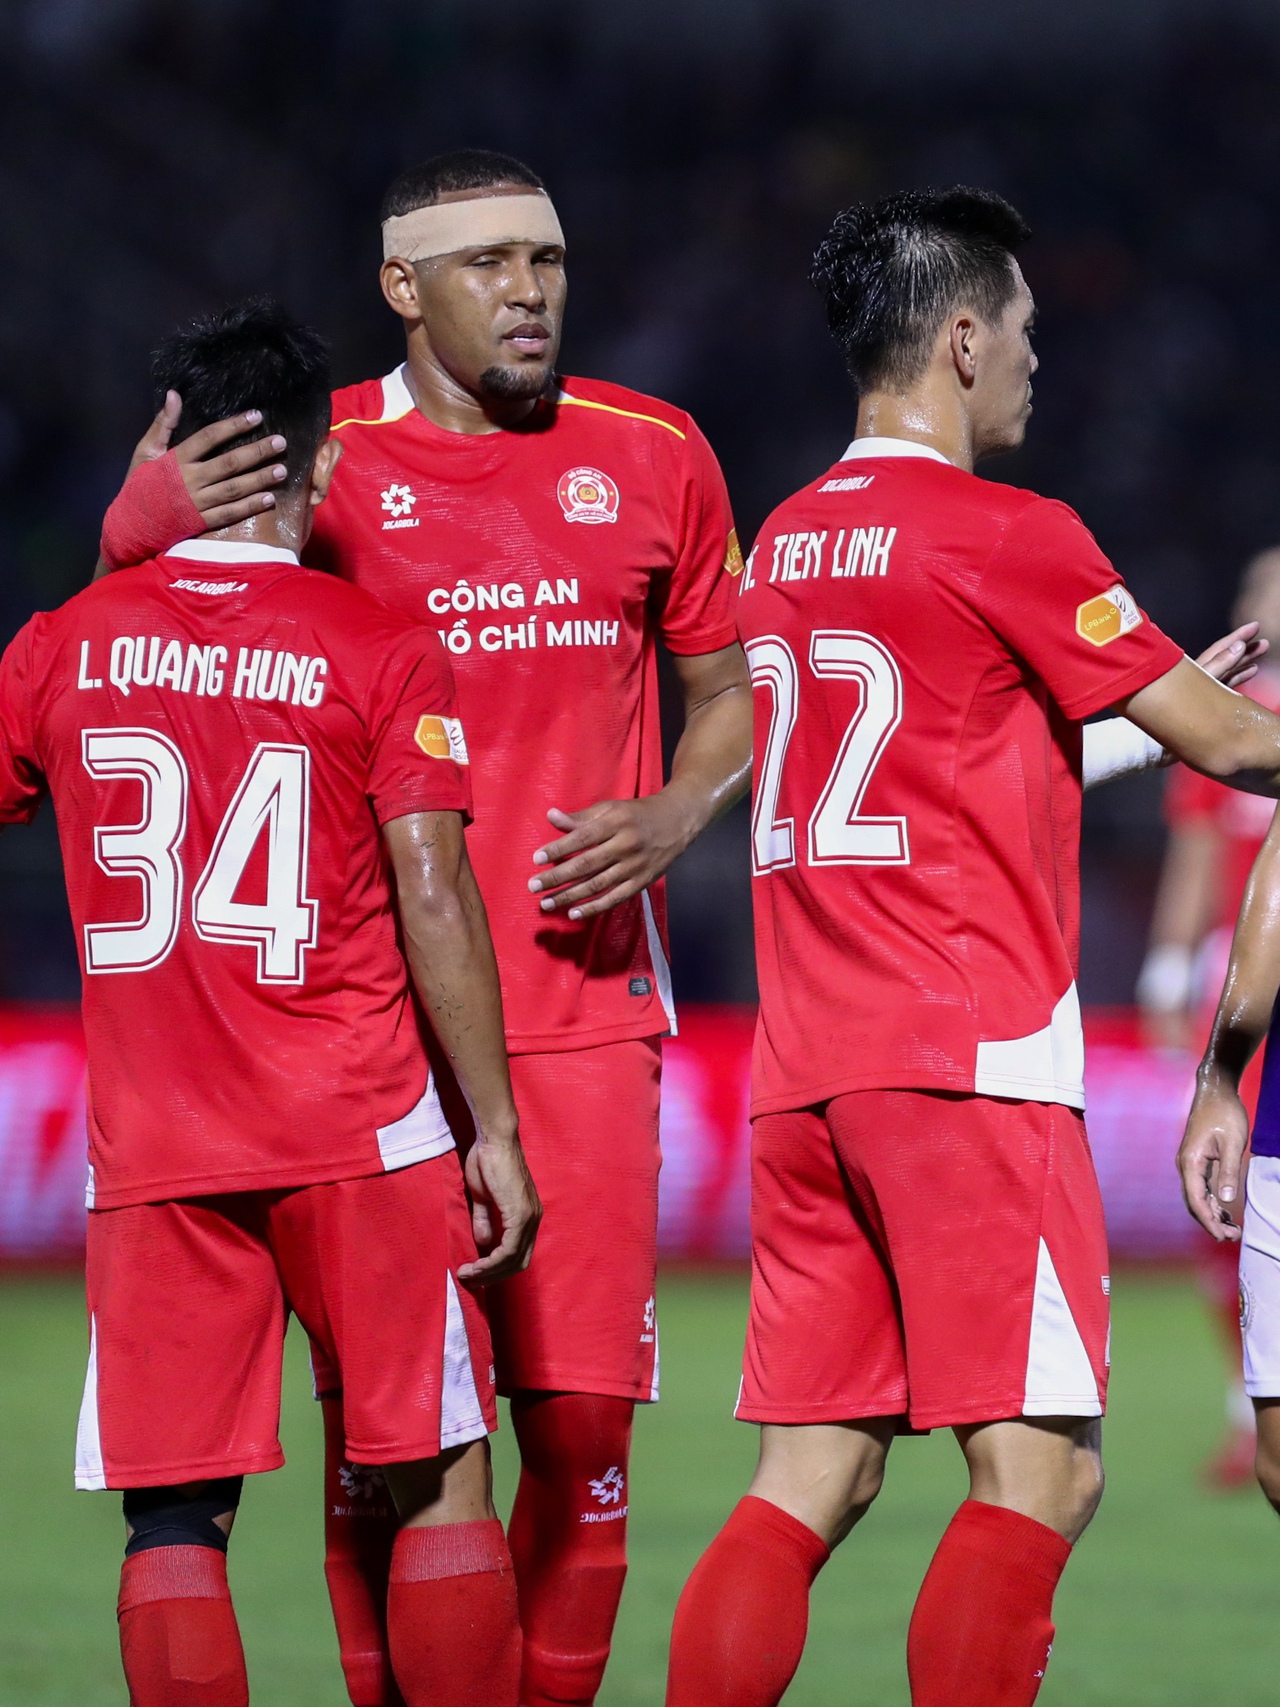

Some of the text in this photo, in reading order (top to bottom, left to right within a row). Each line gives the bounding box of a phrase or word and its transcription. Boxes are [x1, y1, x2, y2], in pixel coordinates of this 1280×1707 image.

[768, 530, 828, 583] TIEN
[831, 526, 898, 578] LINH
[169, 578, 248, 596] JOGARBOLA
[427, 578, 579, 614] CÔNG AN
[479, 614, 538, 652] CHÍ
[546, 620, 619, 647] MINH
[1084, 613, 1112, 631] LPBank
[77, 636, 327, 708] L. QUANG HUNG
[744, 629, 911, 877] 22
[81, 726, 319, 985] 34
